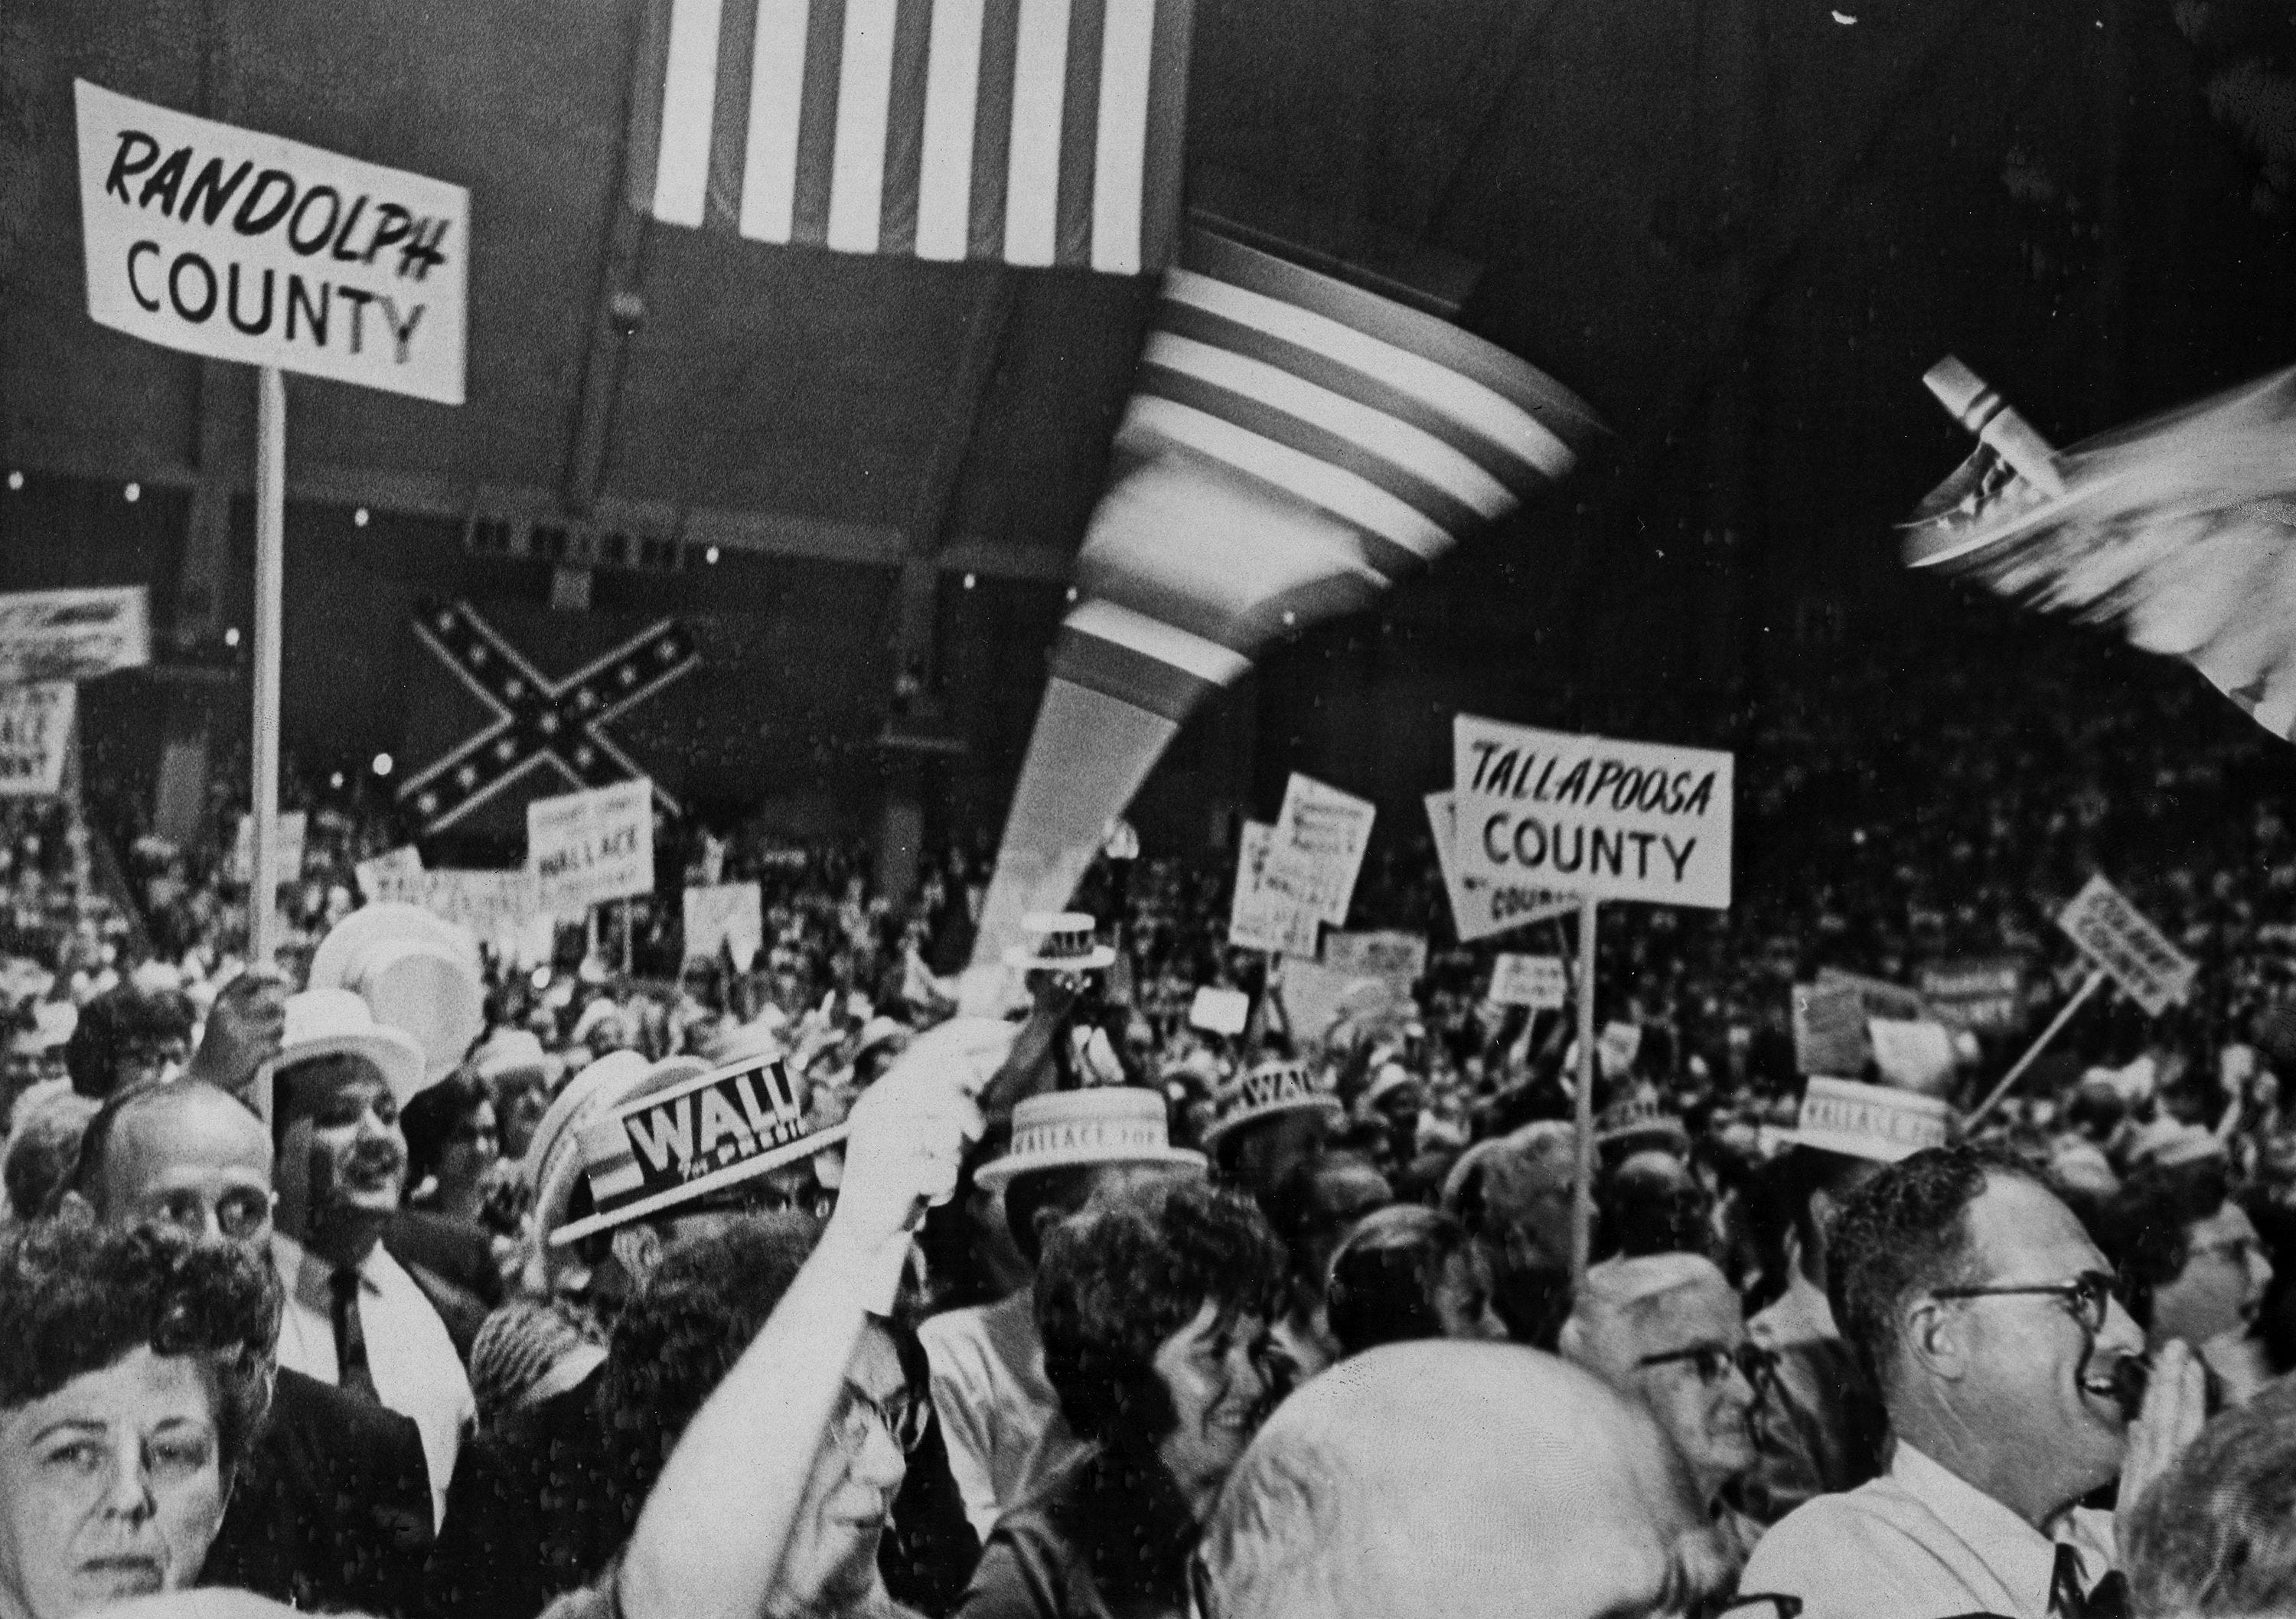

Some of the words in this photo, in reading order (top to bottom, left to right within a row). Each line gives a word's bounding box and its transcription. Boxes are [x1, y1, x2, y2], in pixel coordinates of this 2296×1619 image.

[106, 129, 452, 282] RANDOLPH
[127, 240, 426, 364] COUNTY
[1471, 740, 1717, 818] TALLAPOOSA
[1482, 812, 1697, 882] COUNTY
